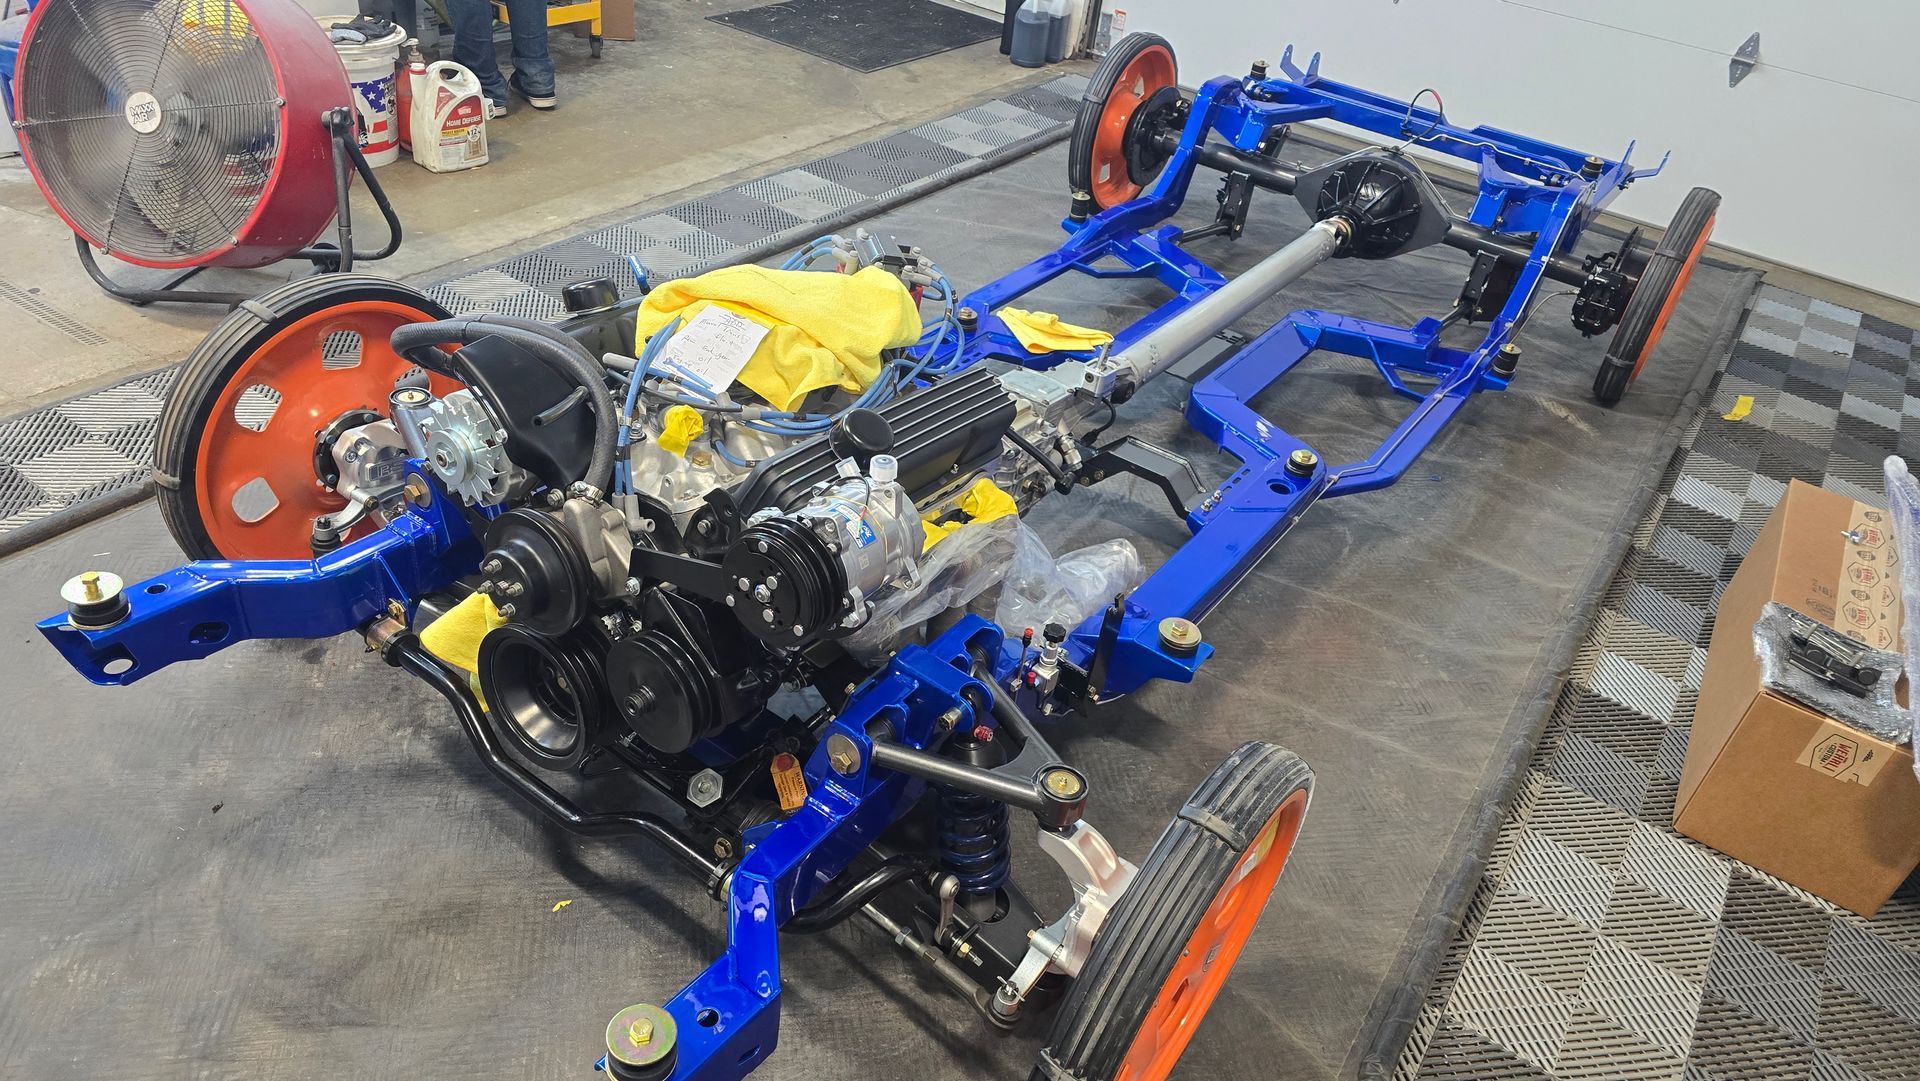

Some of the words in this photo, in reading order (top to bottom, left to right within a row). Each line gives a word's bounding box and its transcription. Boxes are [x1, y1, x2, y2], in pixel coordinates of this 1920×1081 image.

[129, 101, 155, 116] MAXX
[133, 112, 150, 124] AIR
[446, 119, 461, 127] HOME
[462, 115, 481, 124] DEFENSE
[1820, 744, 1837, 764] CUSTOM
[1822, 743, 1852, 773] WEHRLI
